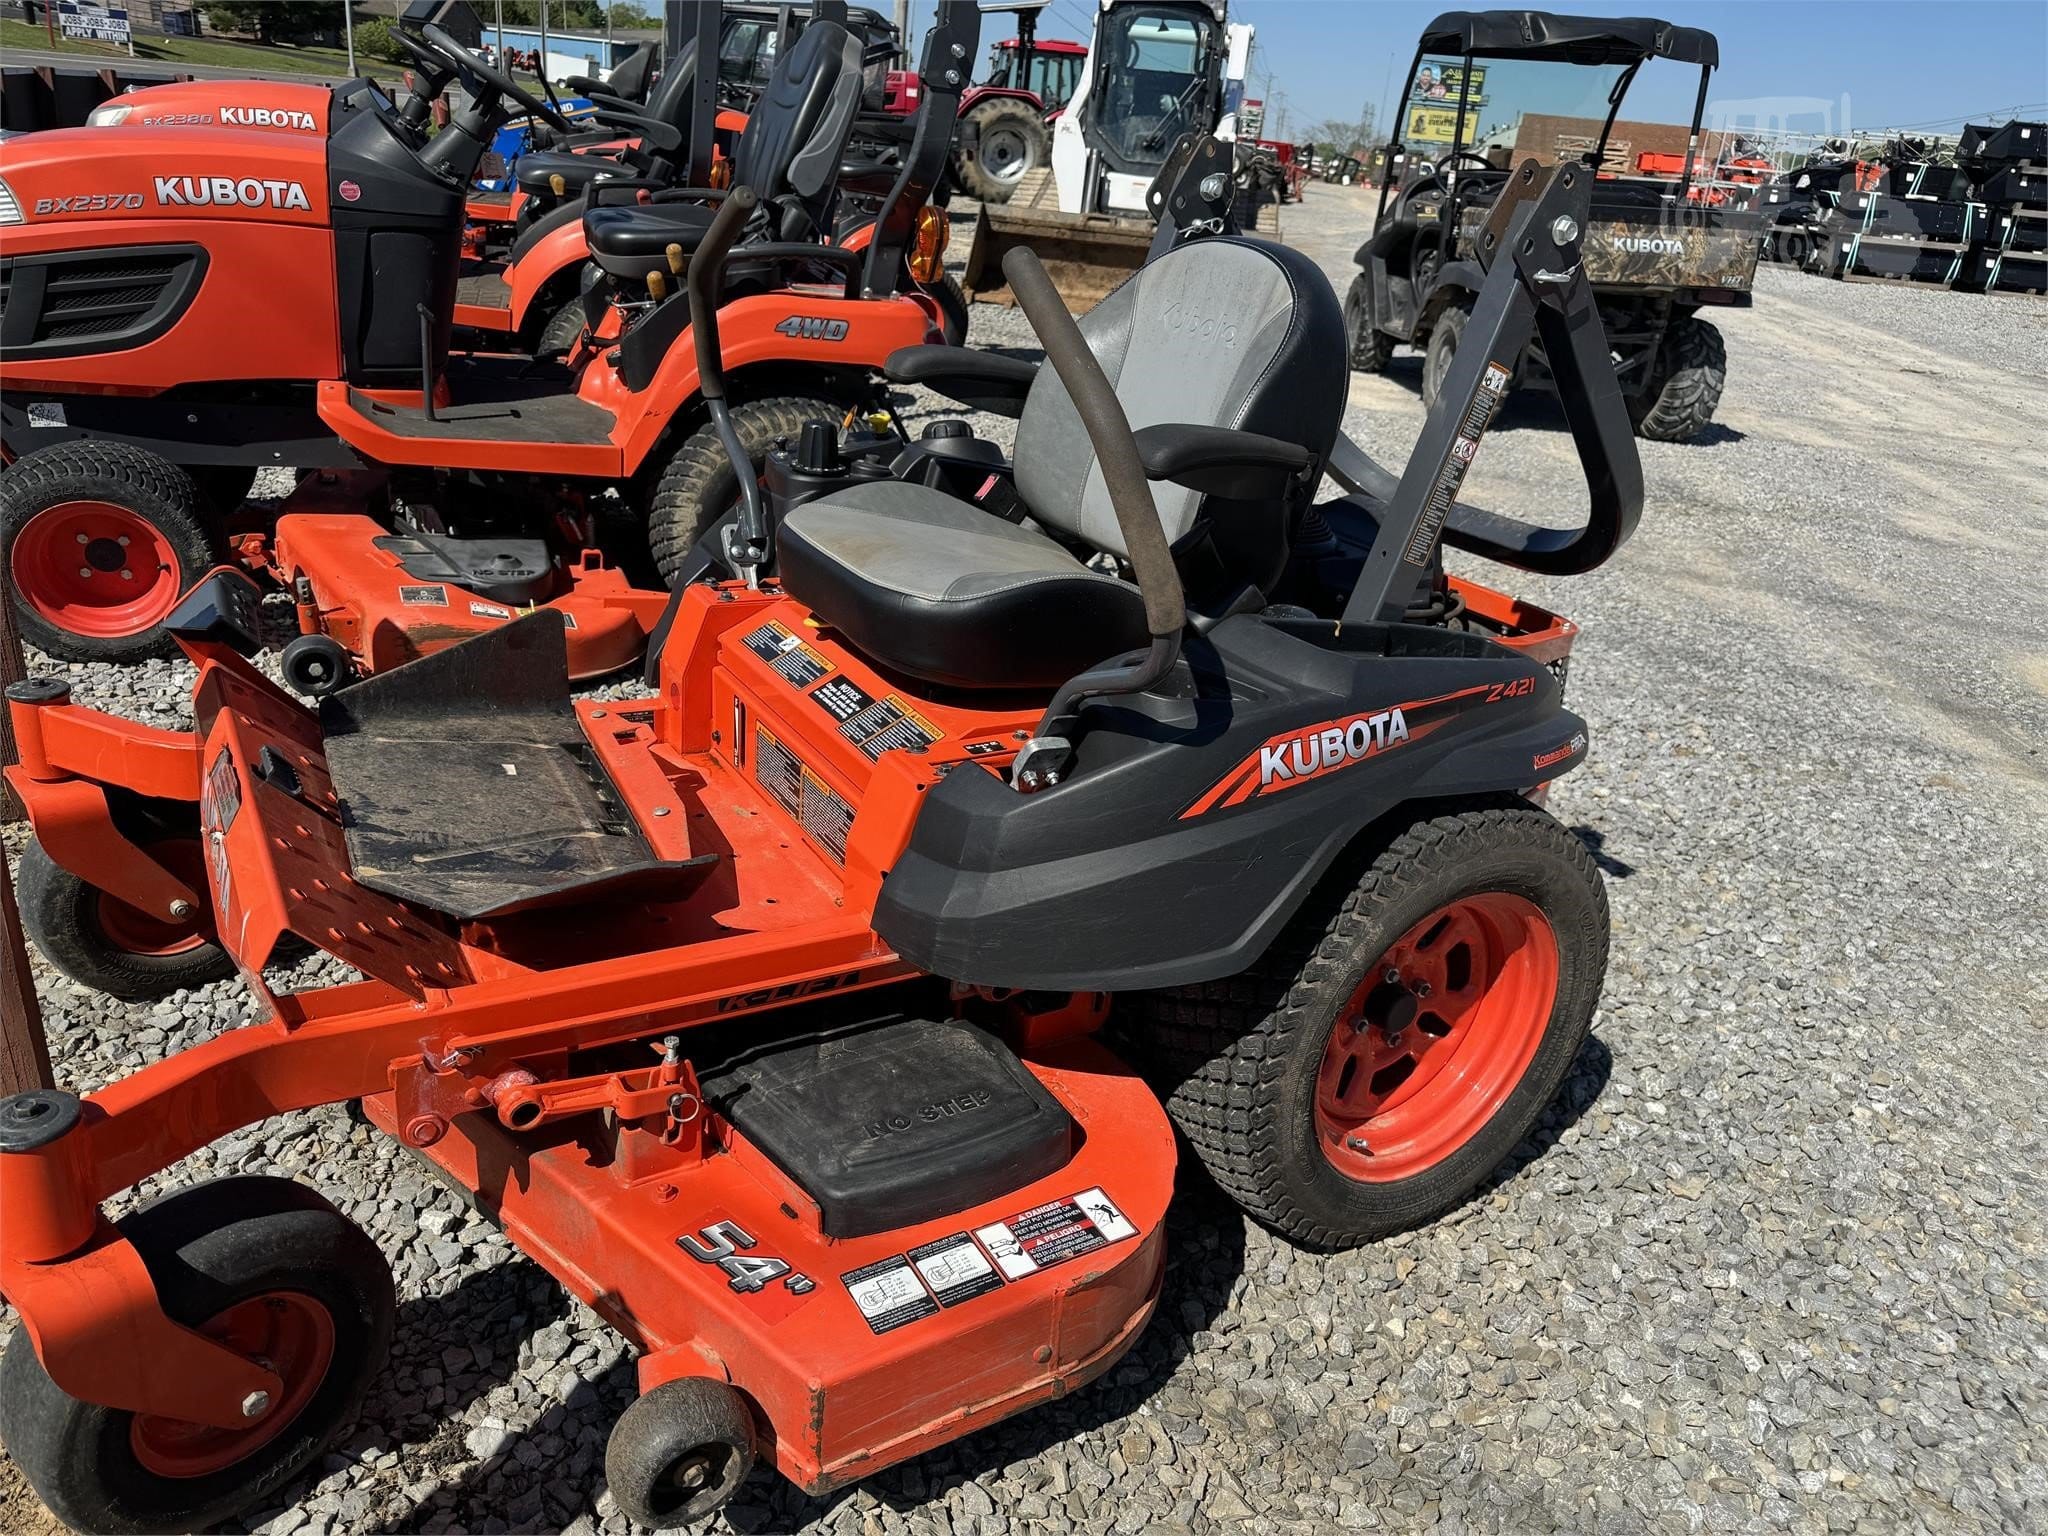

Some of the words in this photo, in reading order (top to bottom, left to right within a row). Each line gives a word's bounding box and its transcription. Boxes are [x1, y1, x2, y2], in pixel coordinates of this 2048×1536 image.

[65, 25, 92, 37] APPLY
[95, 29, 128, 42] WITHIN
[219, 106, 317, 131] KUBOTA
[34, 193, 144, 215] BX2370
[152, 176, 312, 211] KUBOTA
[1613, 237, 1684, 255] KUBOTA
[774, 314, 850, 341] 4WD
[839, 683, 862, 702] NOTICE
[1486, 677, 1535, 703] Z421
[1259, 706, 1410, 785] KUBOTA
[723, 971, 858, 1011] K-LIFT
[861, 1114, 913, 1141] NO
[917, 1090, 991, 1123] STEP
[1014, 1227, 1029, 1235] FEET
[1042, 1215, 1065, 1225] MOWER
[1064, 1209, 1081, 1217] WHEN
[1025, 1201, 1062, 1218] DANGER
[1043, 1209, 1062, 1218] HANDS
[1044, 1225, 1082, 1242] PELIGRO
